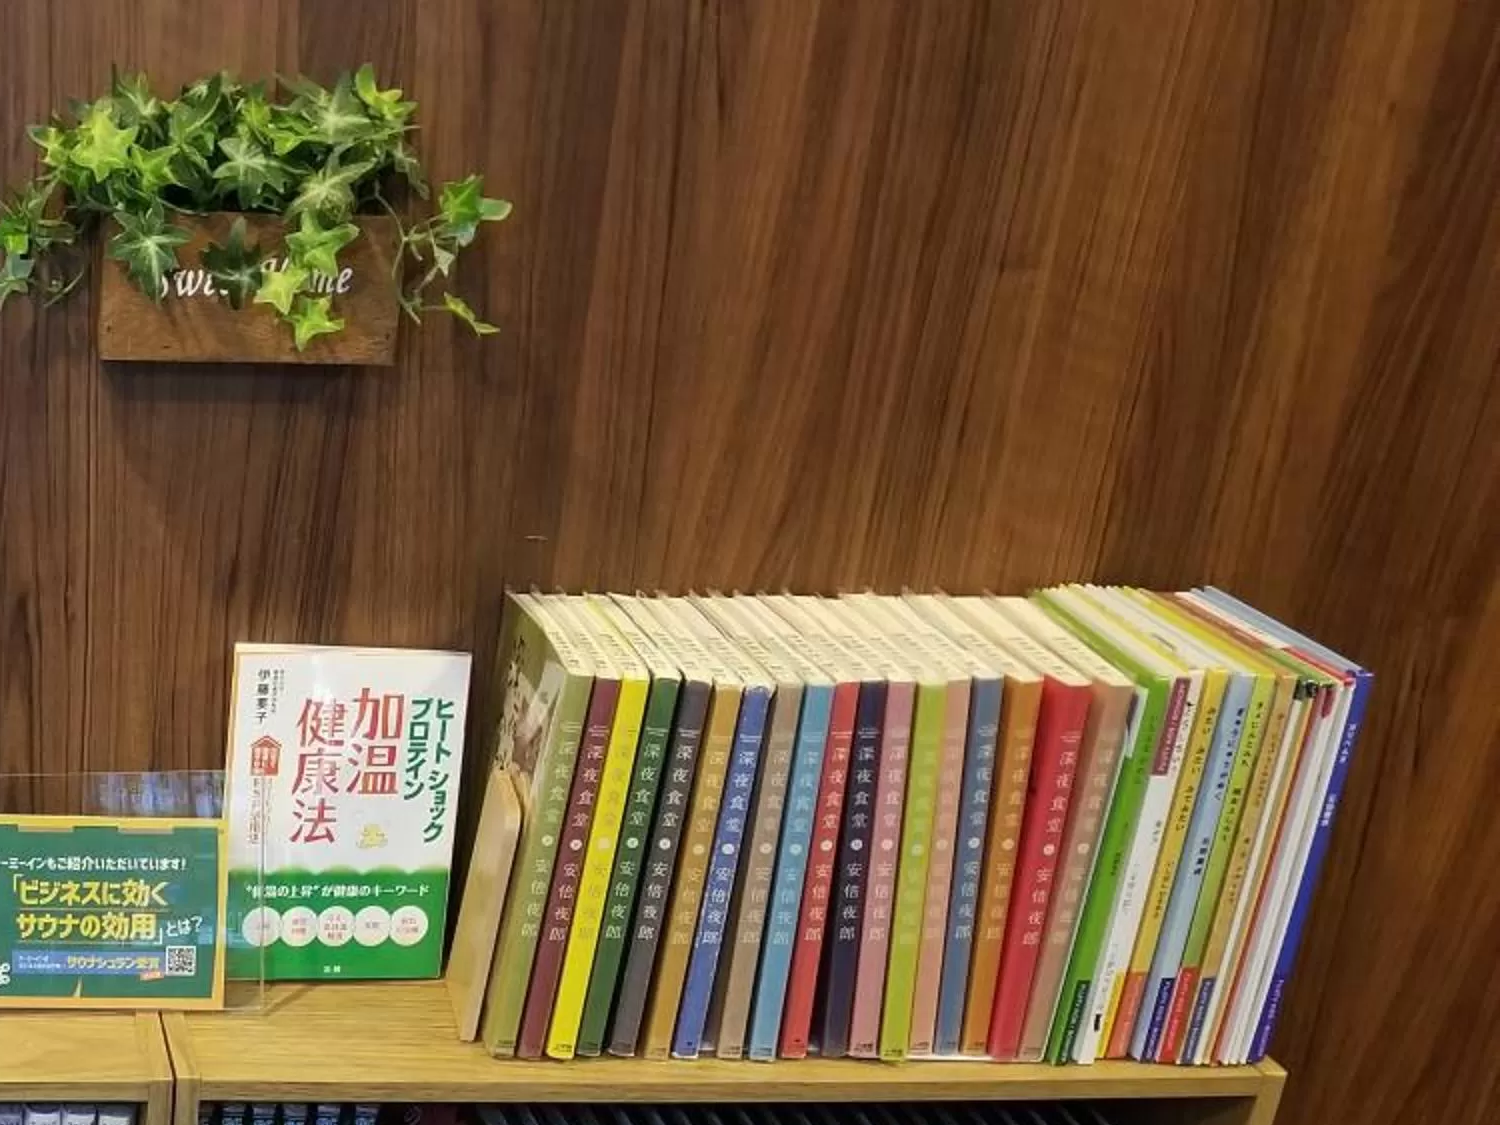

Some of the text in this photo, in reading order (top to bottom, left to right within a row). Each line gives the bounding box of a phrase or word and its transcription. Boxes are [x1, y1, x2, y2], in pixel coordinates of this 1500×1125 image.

[289, 697, 349, 844] 健康法
[346, 687, 405, 795] 加温
[572, 743, 604, 827] 深夜食堂
[629, 743, 660, 826] 深夜食堂
[663, 743, 693, 827] 深夜食堂
[851, 746, 875, 829] 深夜食堂
[638, 861, 668, 940] 安倍夜郎
[839, 863, 863, 939] 安倍夜郎
